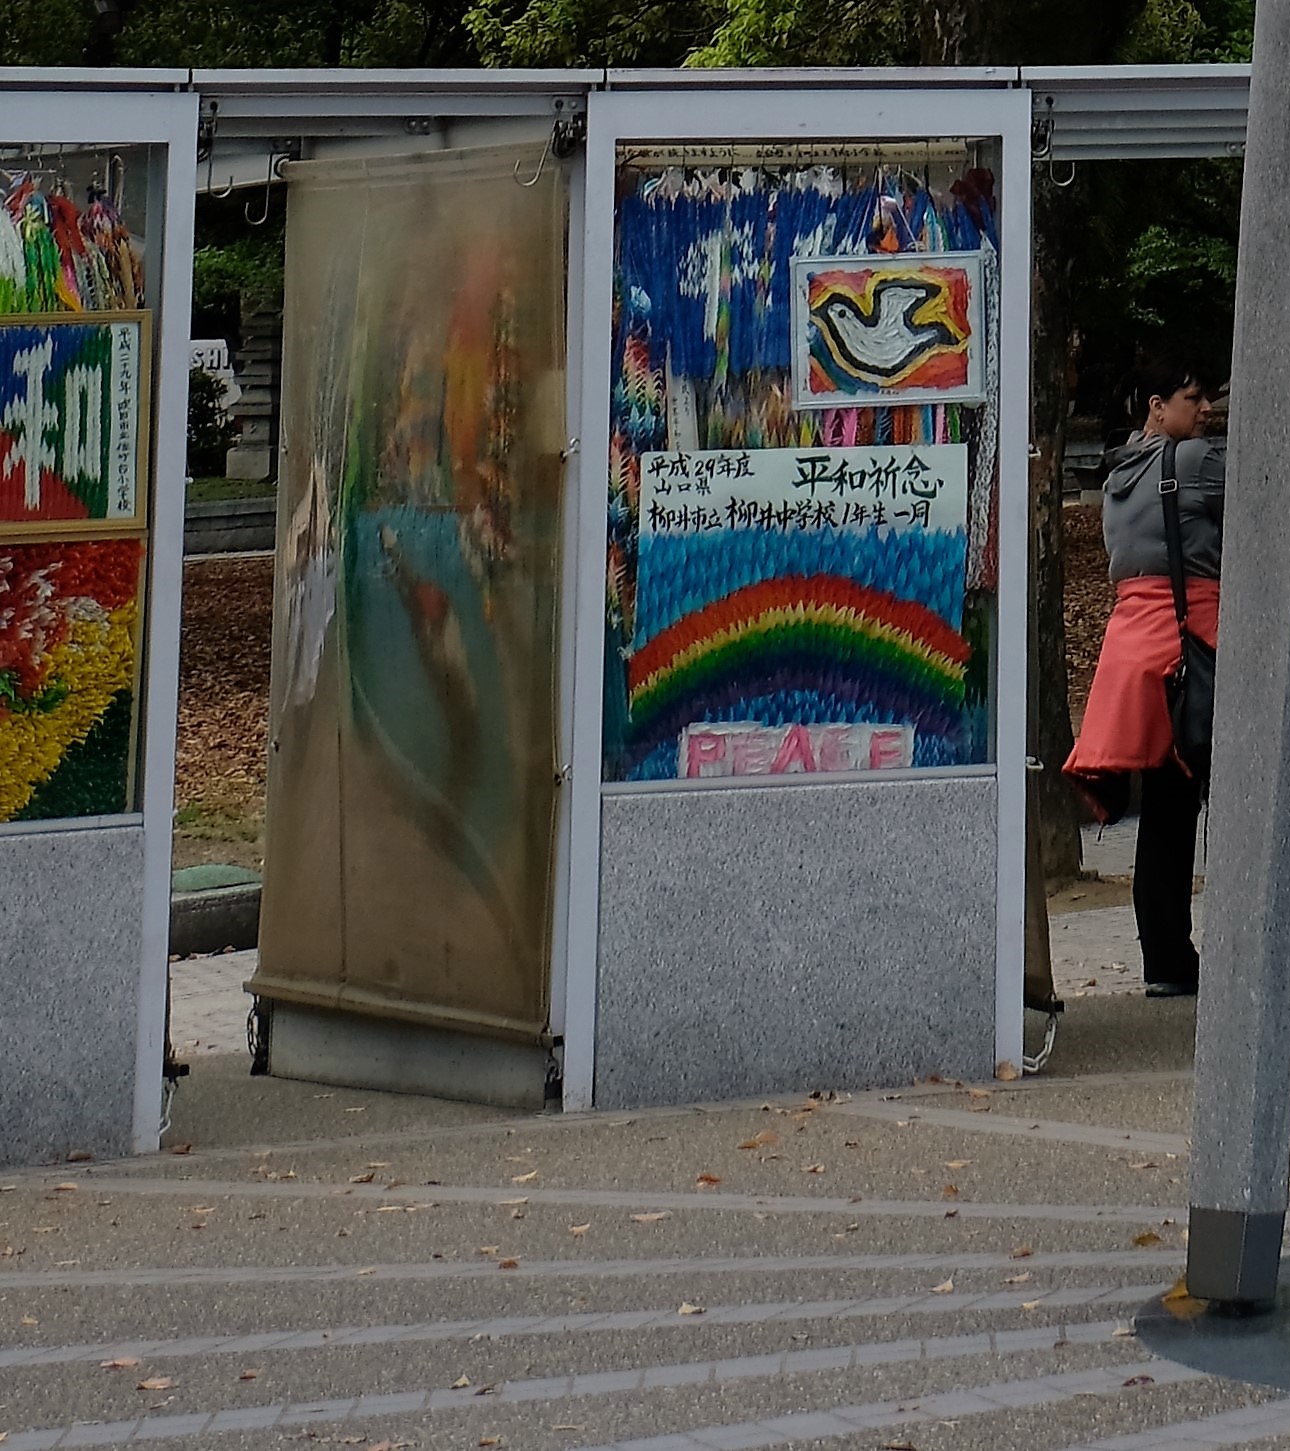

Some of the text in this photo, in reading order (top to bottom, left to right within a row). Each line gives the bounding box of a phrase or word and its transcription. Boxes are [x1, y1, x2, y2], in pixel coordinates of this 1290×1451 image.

[647, 452, 944, 498] 平成29年度 平和祈念
[653, 477, 711, 496] 山口県
[687, 725, 902, 779] PEACE
